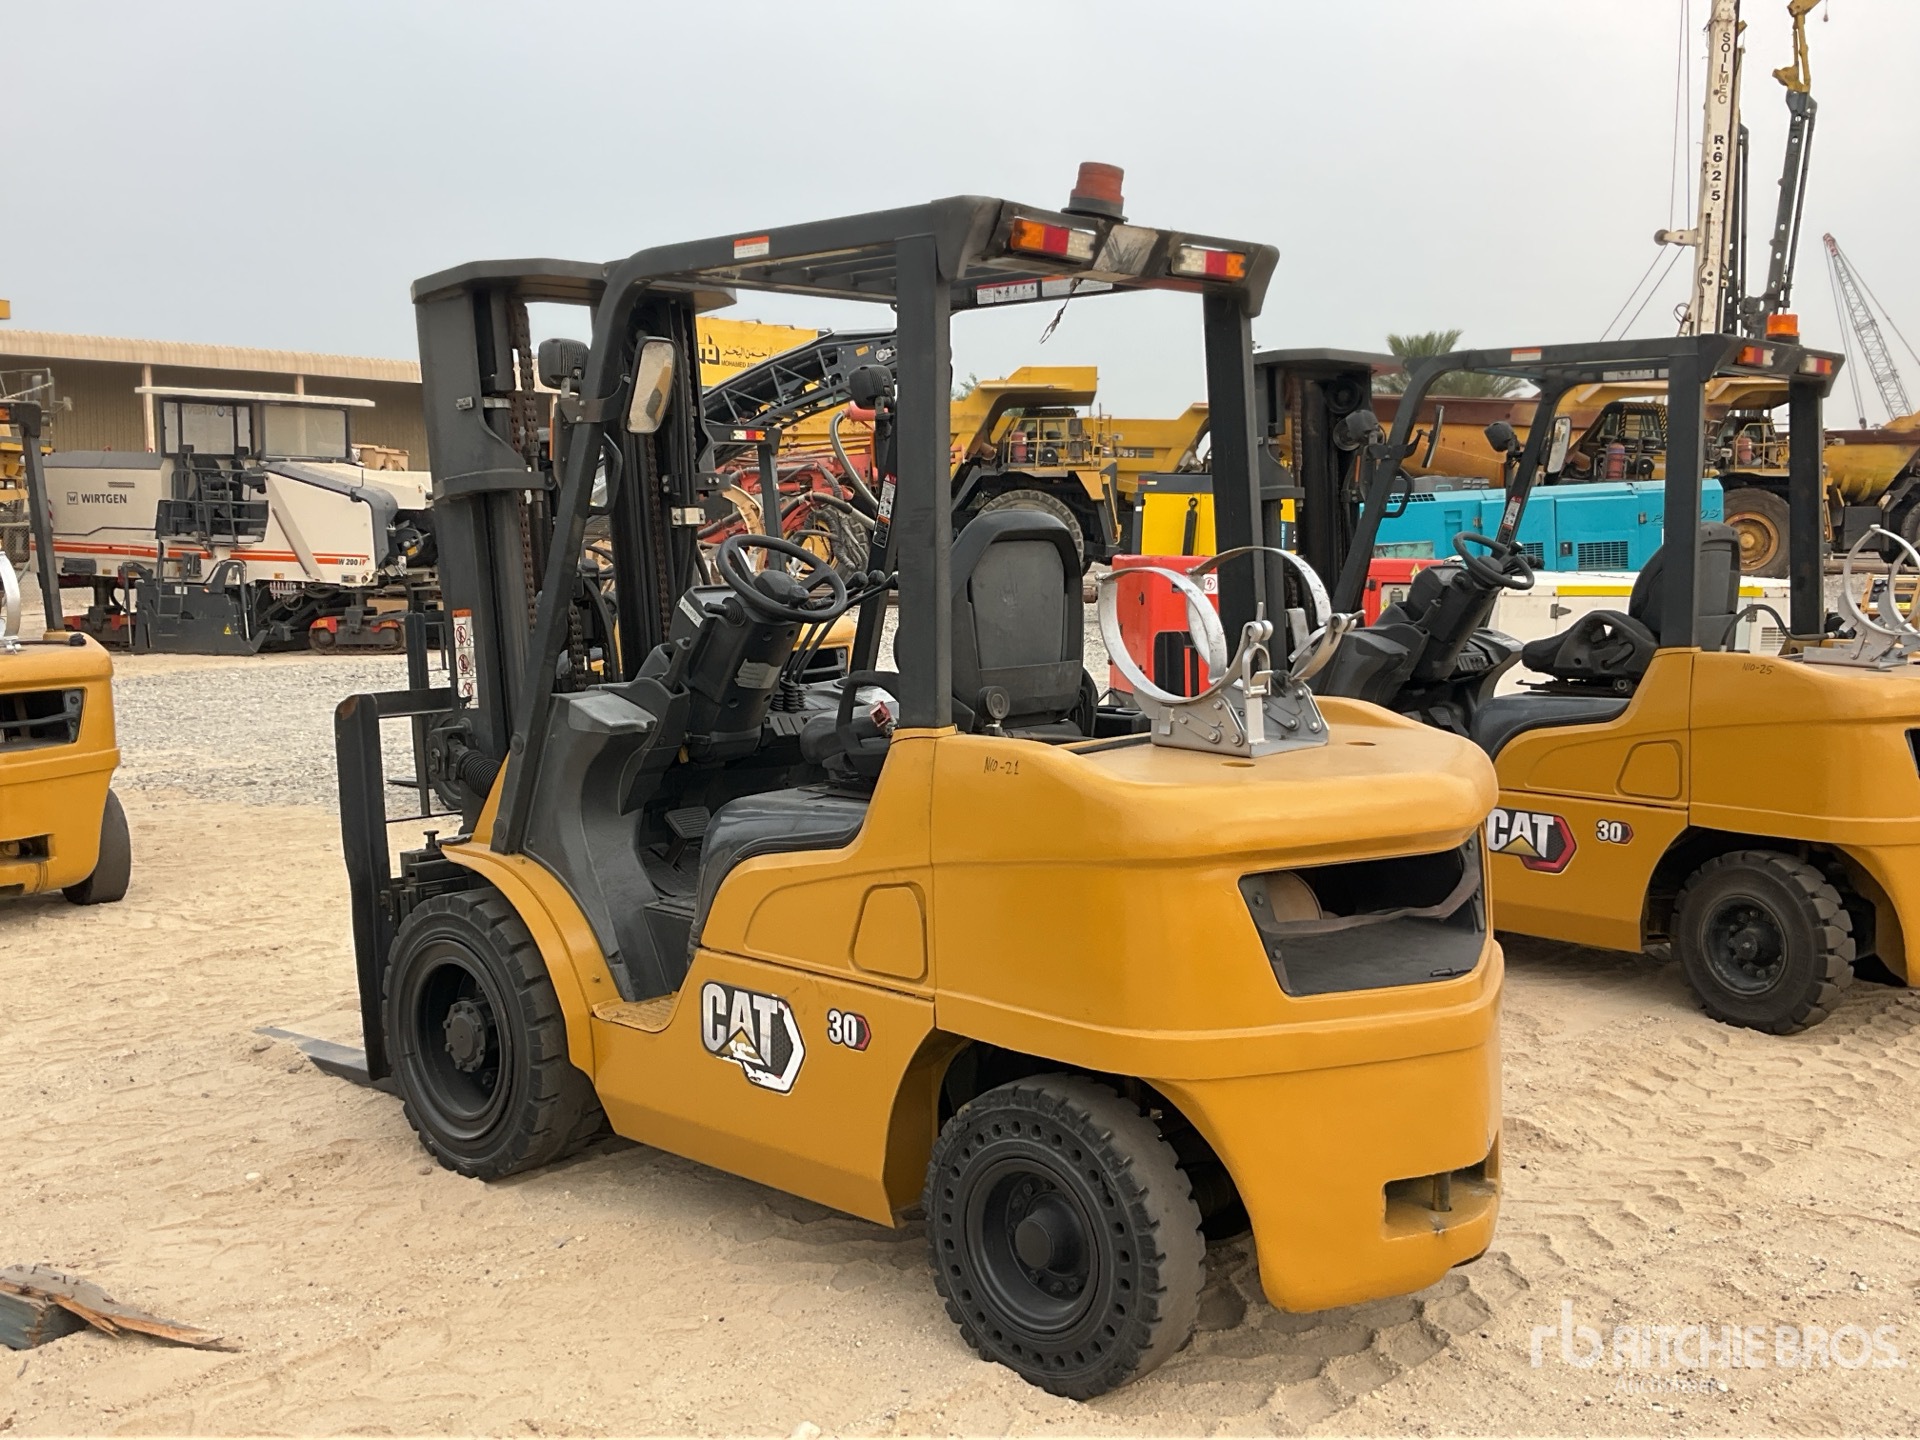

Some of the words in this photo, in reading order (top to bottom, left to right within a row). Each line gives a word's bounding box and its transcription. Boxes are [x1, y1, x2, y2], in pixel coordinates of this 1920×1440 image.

[1717, 32, 1731, 105] SOILMEC
[81, 494, 127, 503] WIRTGEN
[1488, 808, 1554, 858] CAT
[1597, 820, 1621, 842] 30
[702, 983, 777, 1067] CAT
[828, 1009, 857, 1047] 30
